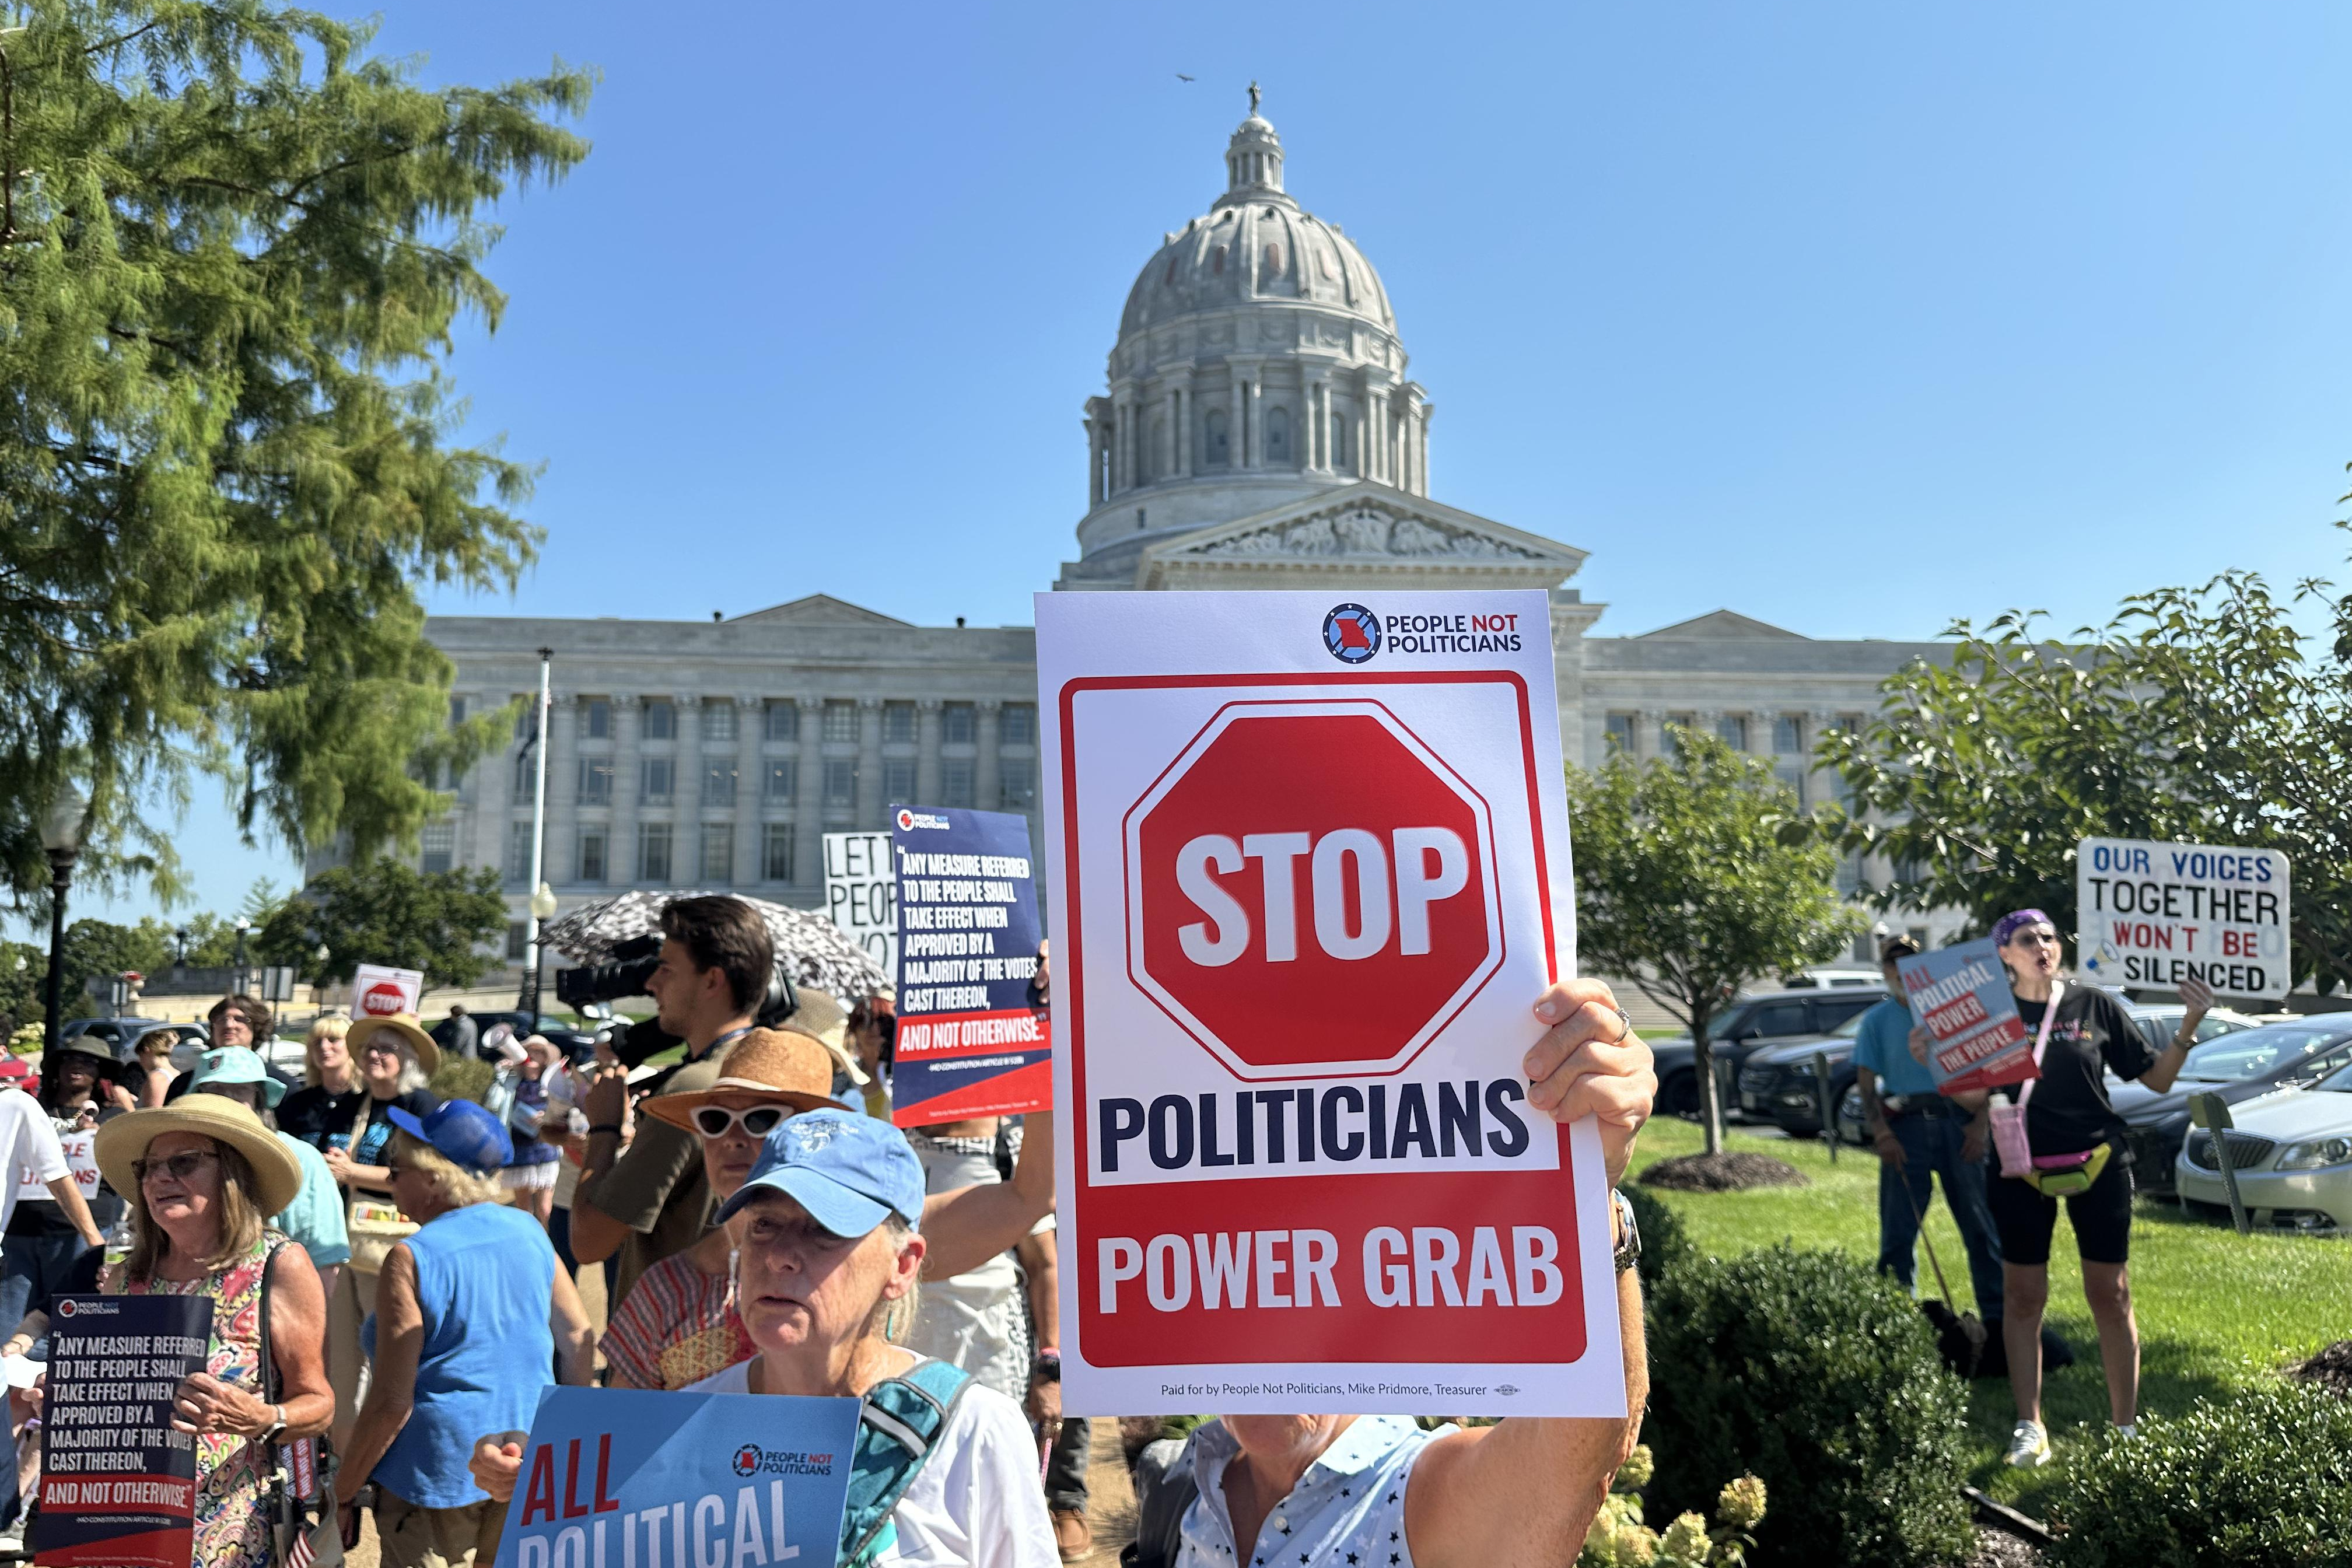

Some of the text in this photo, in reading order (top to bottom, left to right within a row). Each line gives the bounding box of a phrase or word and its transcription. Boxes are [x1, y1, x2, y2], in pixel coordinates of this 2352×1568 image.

[1386, 614, 1518, 633] PEOPLE NOT
[1388, 635, 1521, 653] POLITICIANS
[827, 836, 878, 878] LET
[928, 853, 982, 877] MEASURE
[982, 856, 1030, 878] REFERRED
[2094, 847, 2272, 882] OUR VOICES
[902, 880, 1017, 903] TO THE PEOPLE SHALL
[1175, 827, 1469, 968] STOP
[2088, 877, 2278, 925] TOGETHER
[903, 907, 1008, 929] TAKE EFFECT WHEN
[905, 934, 968, 957] APPROVED
[969, 933, 986, 955] BY
[985, 933, 994, 954] A
[2113, 922, 2258, 958] WON'T BE
[905, 957, 1038, 985] MAJORITY OF THE VOTES
[1904, 965, 1935, 993] ALL
[2124, 956, 2264, 991] SILENCED
[905, 986, 991, 1012] CAST THEREON,
[1912, 963, 1996, 1014] POLITICAL
[367, 993, 405, 1012] STOP
[1926, 996, 1984, 1037] POWER
[899, 1024, 931, 1052] AND
[933, 1021, 961, 1049] NOT
[1940, 1045, 1966, 1072] THE
[1963, 1026, 2013, 1062] PEOPLE
[1099, 1078, 1530, 1173] POLITICIANS
[1097, 1225, 1564, 1314] POWER GRAB
[86, 1336, 150, 1355] MEASURE
[153, 1336, 206, 1358] REFERRED
[55, 1360, 186, 1378] TO THE PEOPLE SHALL
[52, 1382, 174, 1402] TAKE EFFECT WHEN
[1161, 1385, 1185, 1395] Paid
[1188, 1384, 1203, 1395] for
[1206, 1384, 1220, 1397] by
[1223, 1384, 1259, 1397] People
[1263, 1384, 1283, 1394] Not
[1287, 1383, 1345, 1395] Politicians,
[1349, 1383, 1375, 1394] Mike
[1378, 1383, 1432, 1396] Pridmore,
[1435, 1384, 1487, 1395] Treasurer
[50, 1405, 154, 1426] APPROVED BY A
[50, 1429, 192, 1451] MAJORITY OF THE VOTES
[49, 1452, 147, 1473] CAST THEREON,
[763, 1462, 831, 1475] POLITICIANS
[765, 1451, 834, 1464] PEOPLE NOT
[521, 1433, 620, 1526] ALL
[46, 1483, 78, 1504] AND
[80, 1482, 113, 1504] NOT
